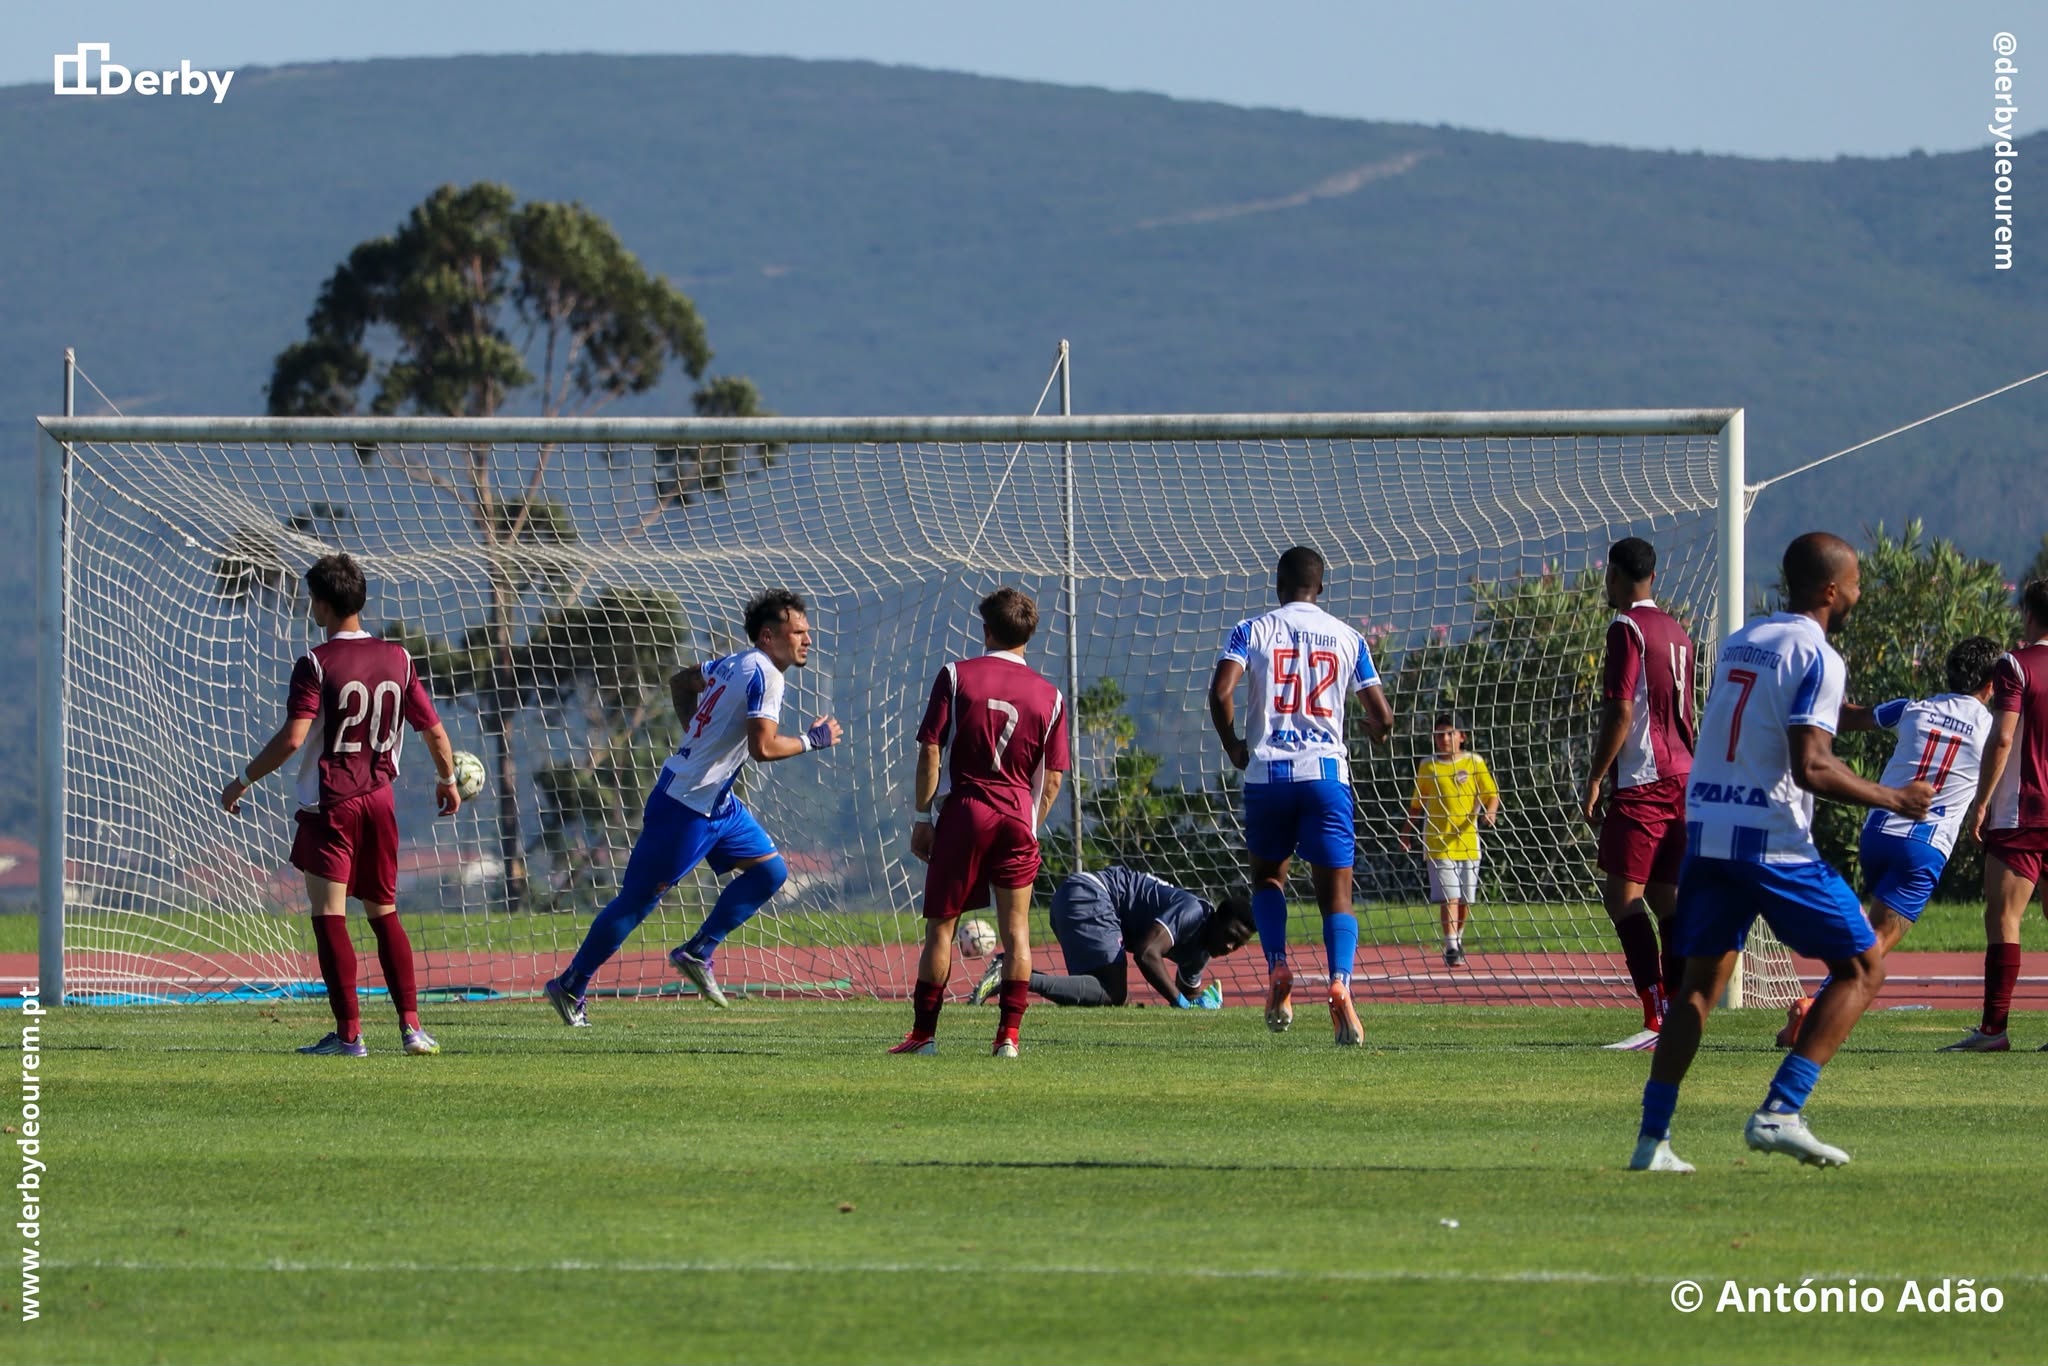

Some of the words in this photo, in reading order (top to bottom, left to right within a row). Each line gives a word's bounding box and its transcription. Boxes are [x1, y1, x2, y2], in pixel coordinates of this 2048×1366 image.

[1289, 631, 1337, 648] VENTURA
[333, 680, 402, 753] 20
[1273, 648, 1339, 718] 52
[1726, 668, 1758, 763] 7
[987, 698, 1019, 772] 7
[1913, 728, 1963, 794] 11
[1942, 716, 1974, 736] PITTA
